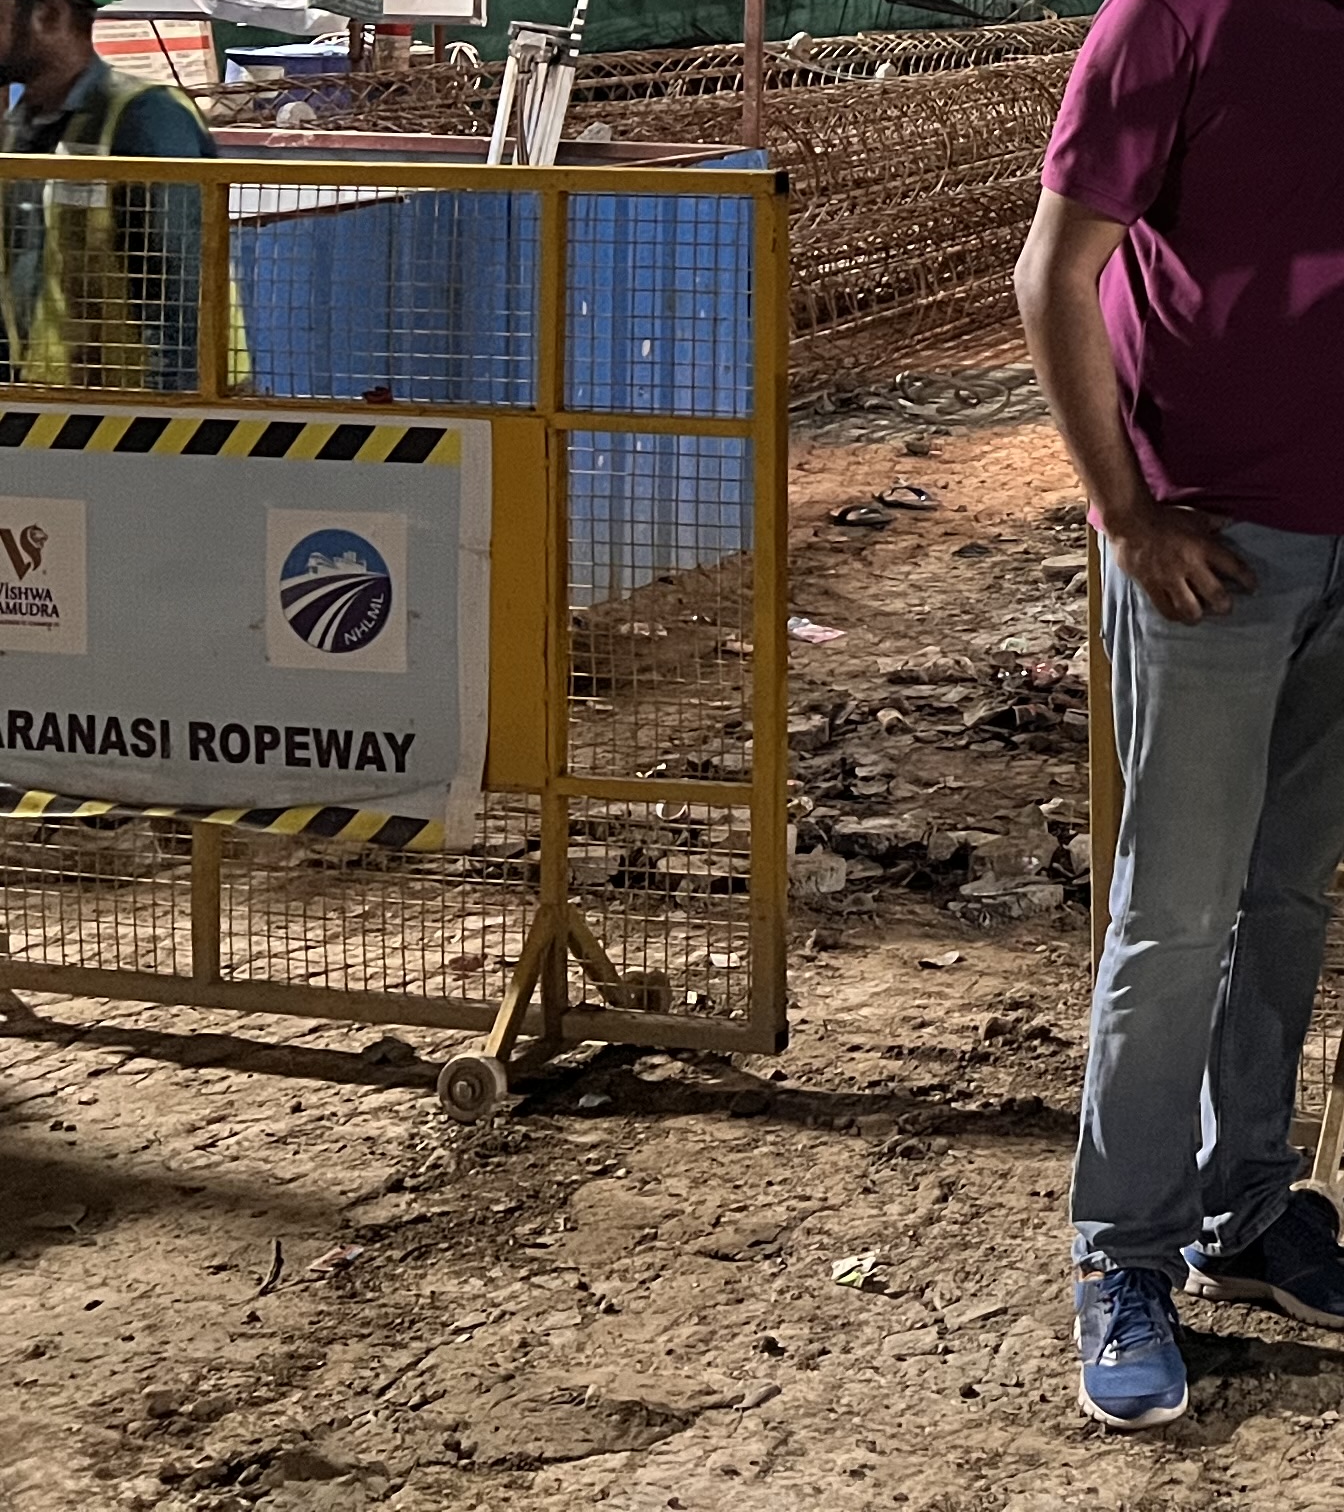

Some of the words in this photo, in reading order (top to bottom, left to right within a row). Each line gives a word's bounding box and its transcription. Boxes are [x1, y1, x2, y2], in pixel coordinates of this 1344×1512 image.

[343, 592, 385, 646] NHLML
[0, 709, 171, 760] RANASI
[188, 720, 416, 773] ROPEWAY
